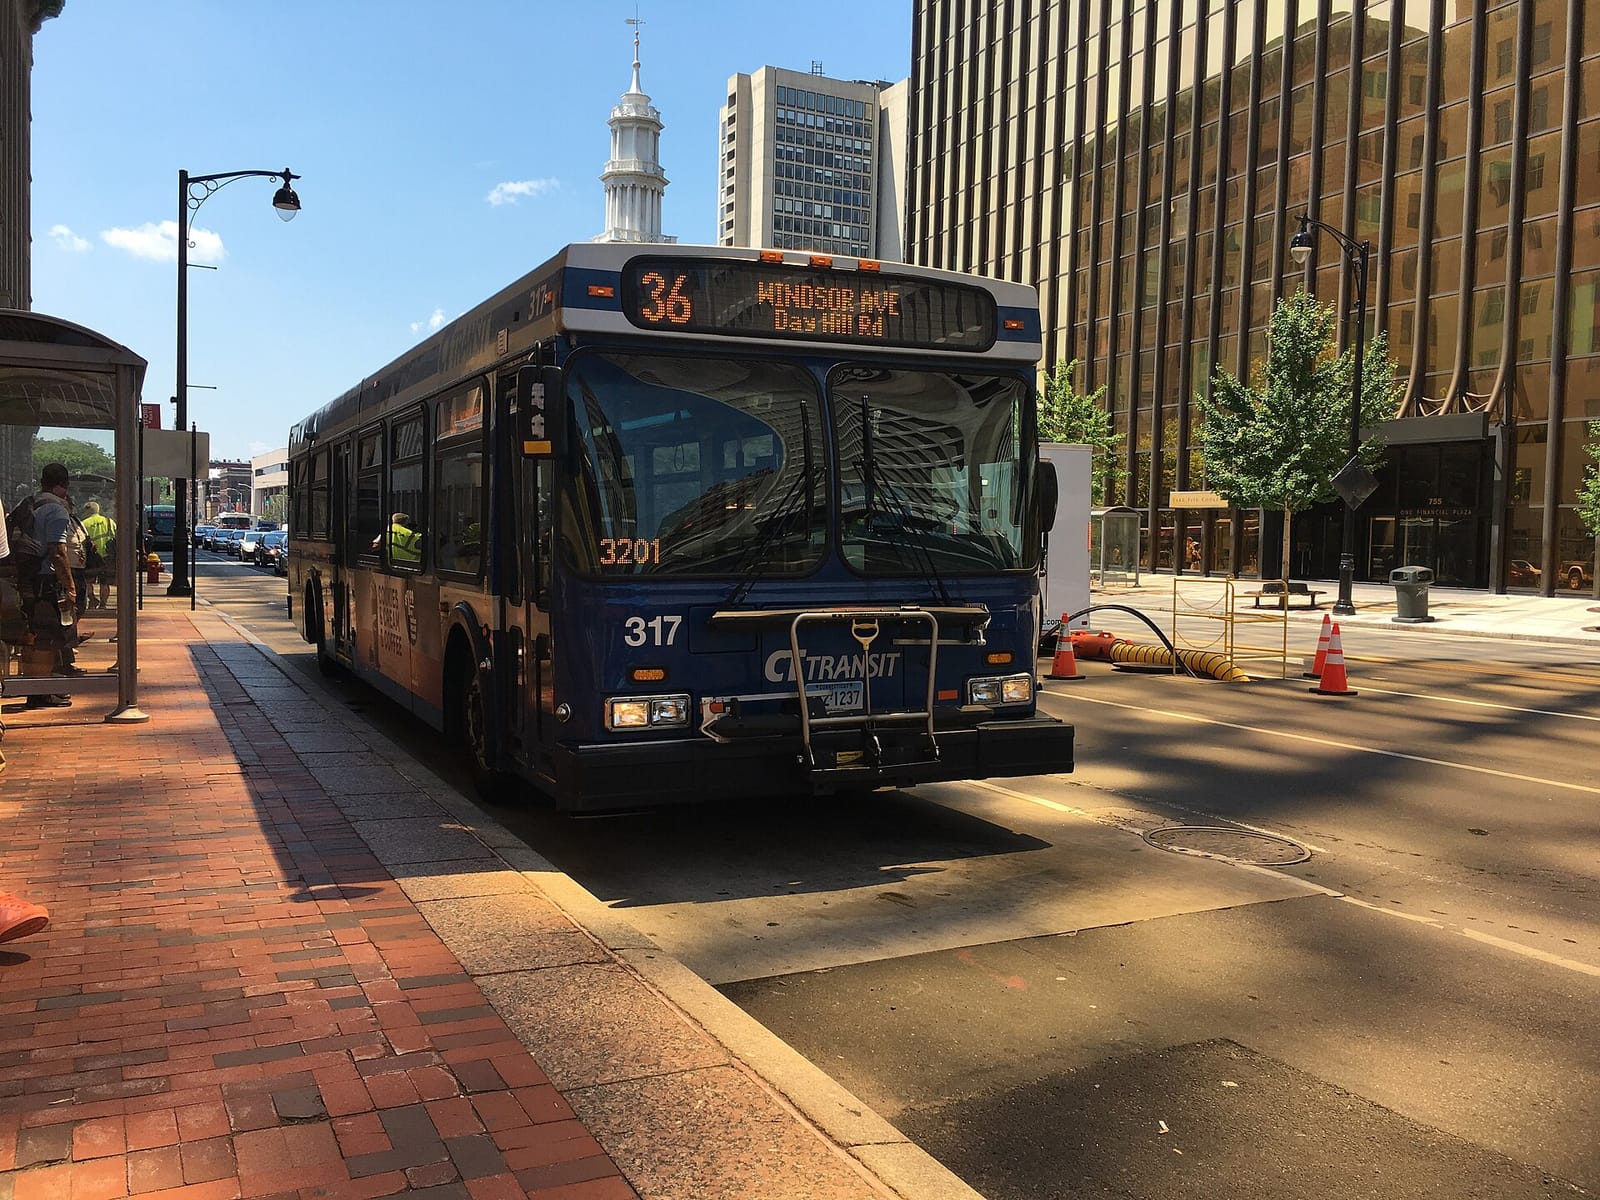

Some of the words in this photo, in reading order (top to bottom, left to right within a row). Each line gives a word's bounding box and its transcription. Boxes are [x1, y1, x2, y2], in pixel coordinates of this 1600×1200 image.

[527, 284, 547, 321] 317
[641, 272, 691, 324] 36
[757, 280, 854, 312] WINDSOR
[860, 290, 900, 317] AVE
[774, 309, 816, 332] Day
[822, 310, 853, 334] Hill
[858, 314, 883, 337] Rd
[1428, 497, 1442, 505] 755
[600, 538, 662, 565] 3201
[624, 616, 682, 647] 317
